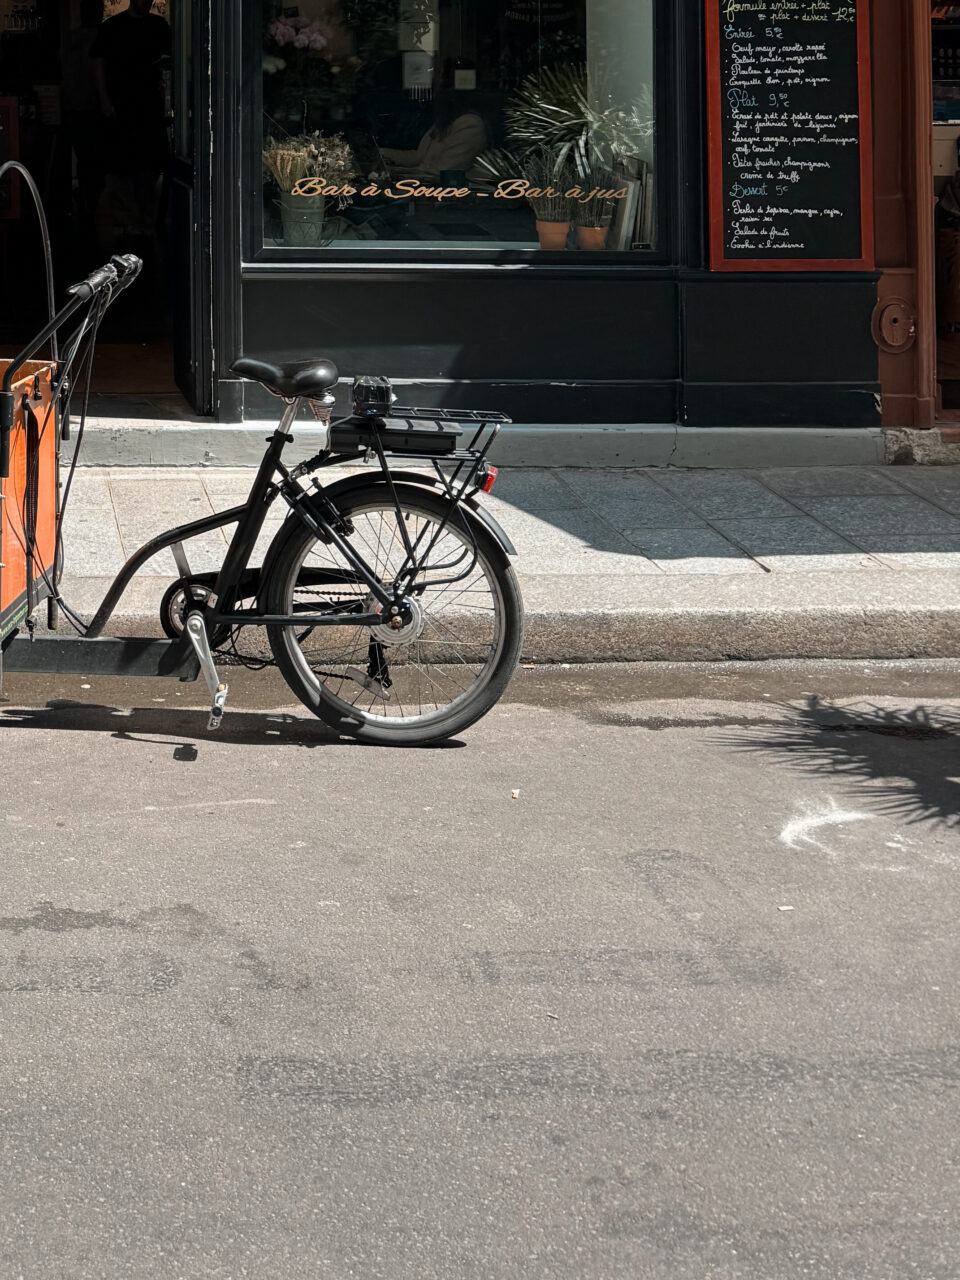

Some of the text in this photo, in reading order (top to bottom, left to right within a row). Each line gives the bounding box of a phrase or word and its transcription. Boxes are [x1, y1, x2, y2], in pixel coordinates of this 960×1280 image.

[771, 10, 790, 24] plat
[802, 13, 828, 21] dessert
[291, 177, 357, 197] Bar
[360, 183, 382, 197] à
[384, 179, 471, 202] Soupe
[493, 179, 560, 199] Bar
[565, 185, 585, 199] à
[578, 186, 629, 204] jus
[730, 182, 768, 198] Dessert
